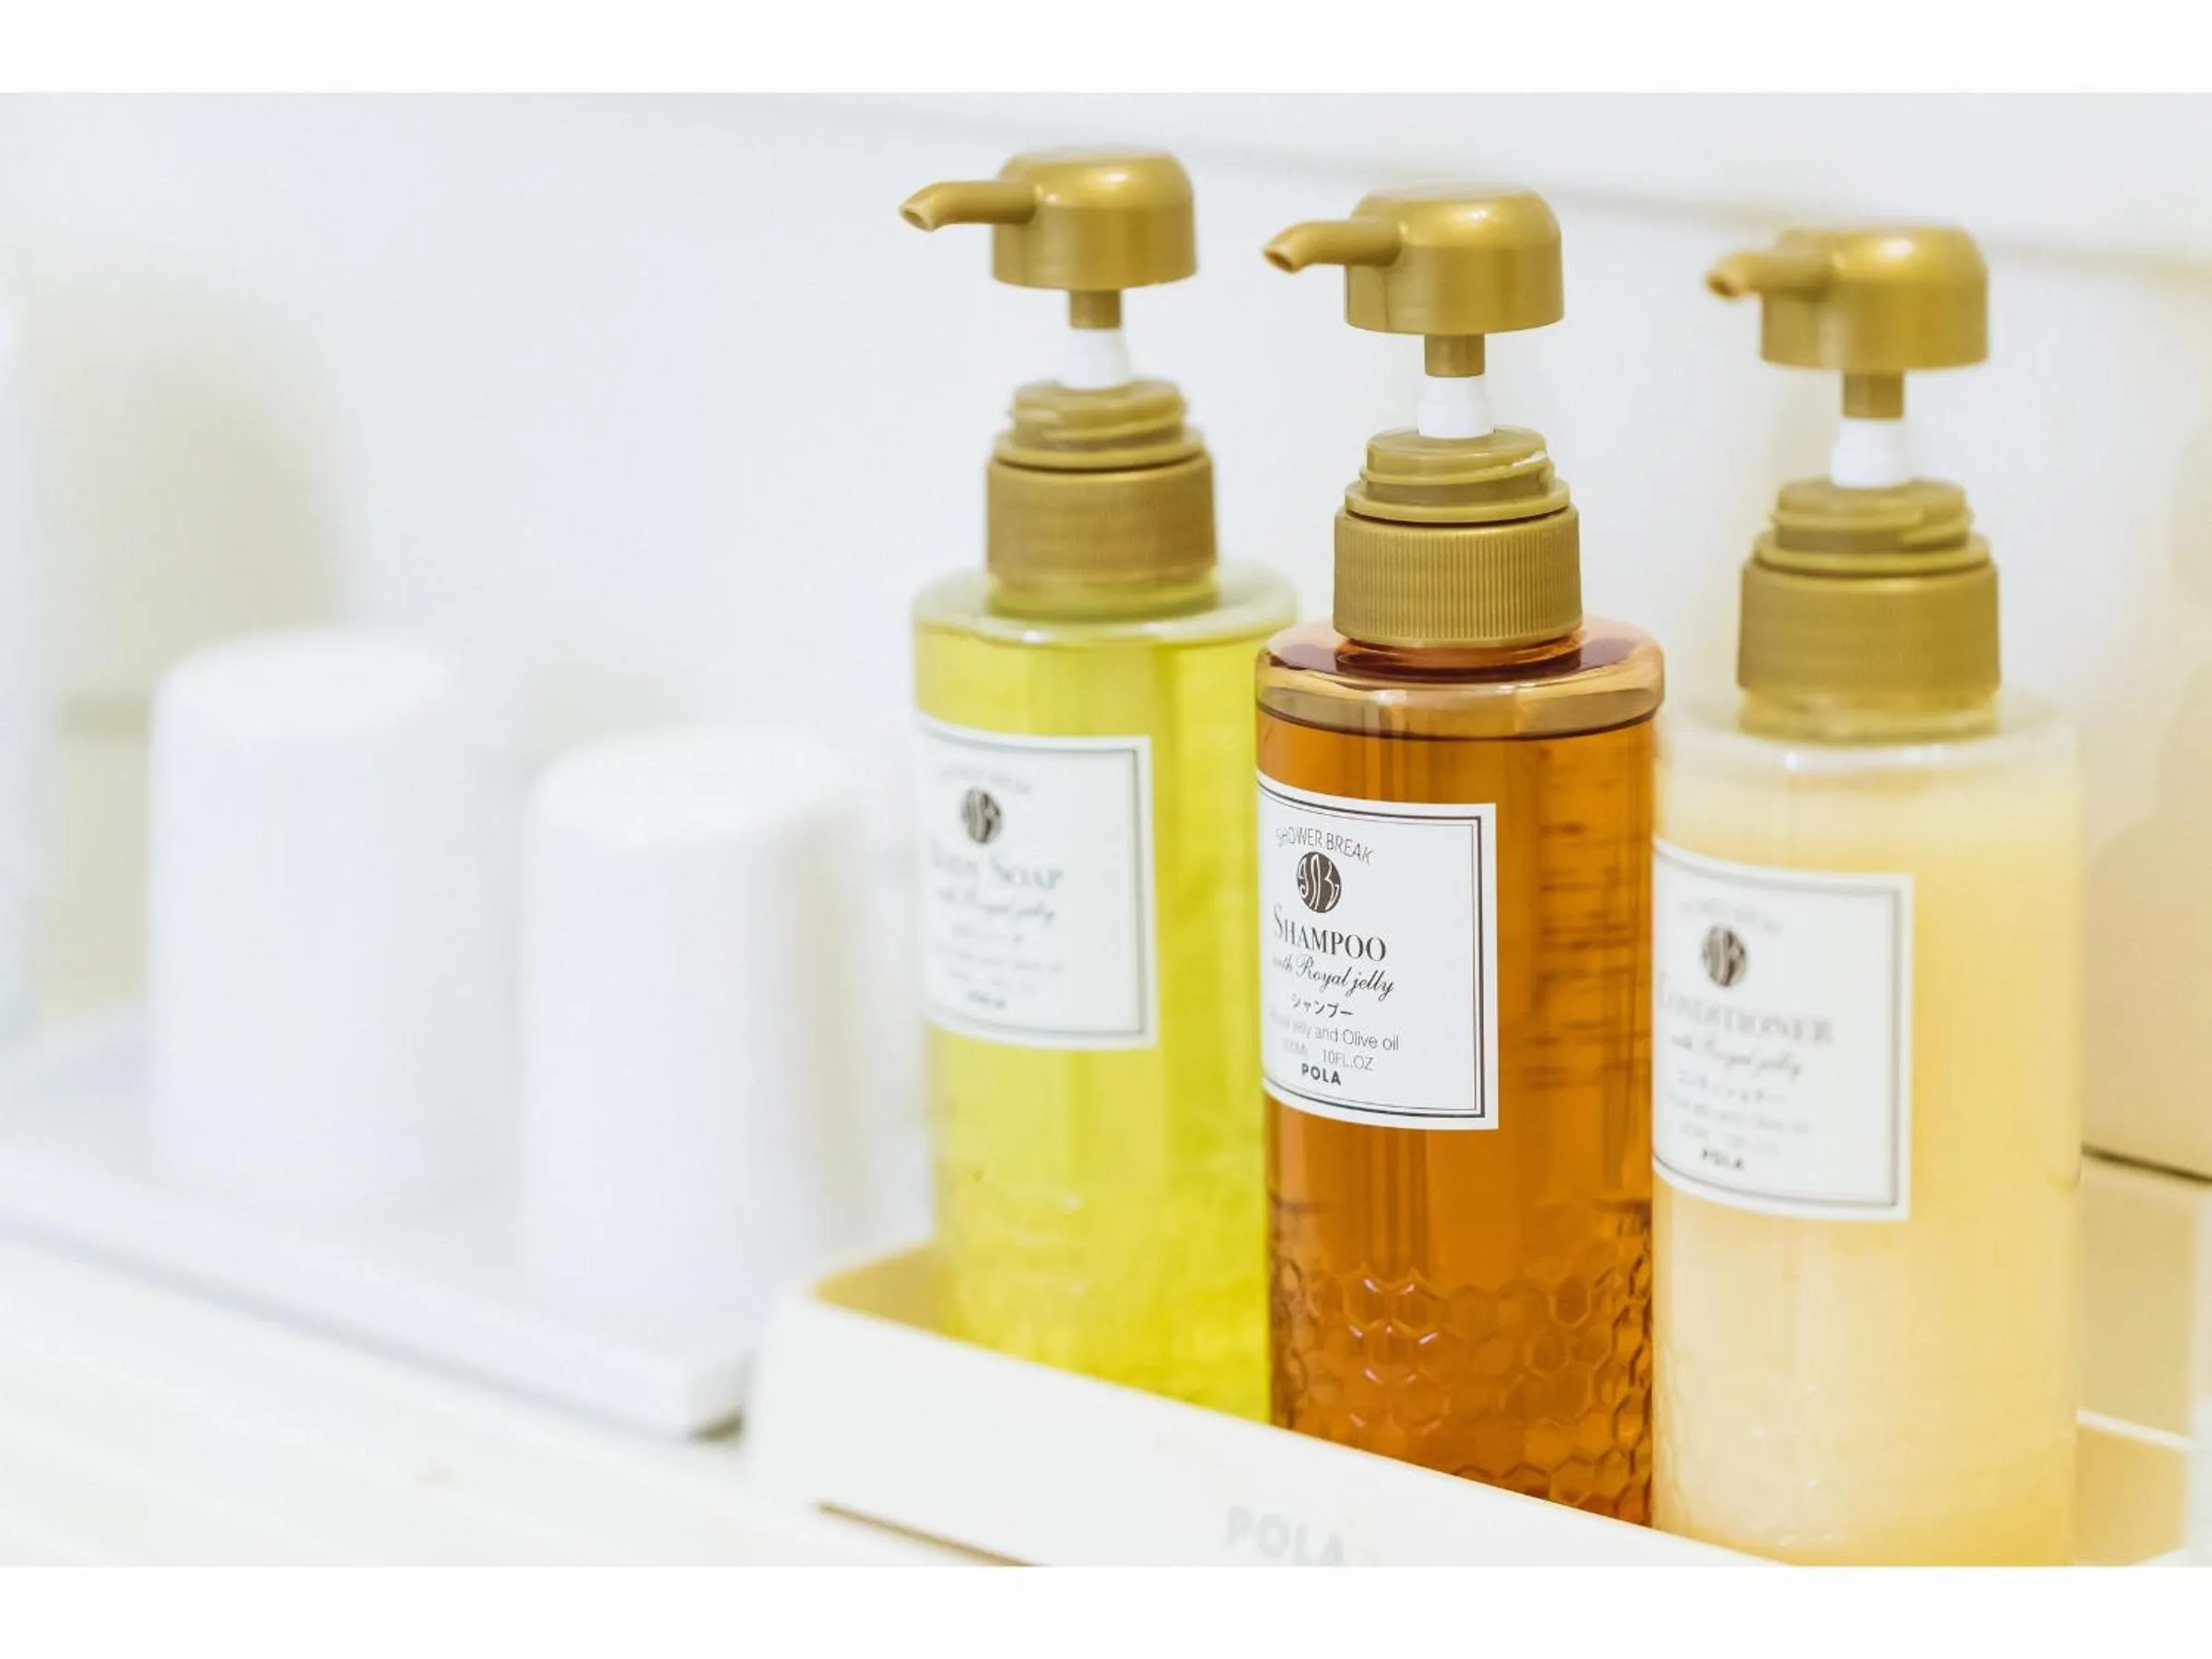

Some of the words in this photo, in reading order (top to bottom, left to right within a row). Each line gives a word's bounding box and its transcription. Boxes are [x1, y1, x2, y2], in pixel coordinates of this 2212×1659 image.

[1275, 826, 1323, 847] SHOWER
[1326, 832, 1374, 865] BREAK
[1273, 902, 1387, 962] SHAMPOO
[1296, 954, 1353, 992] Royal
[1345, 969, 1395, 1002] jelly
[1288, 992, 1355, 1018] シャンプー
[1314, 1025, 1339, 1043] and
[1342, 1029, 1379, 1049] Olive
[1382, 1034, 1400, 1052] oil
[1300, 1062, 1342, 1086] POLA
[1223, 1503, 1346, 1566] POLA
